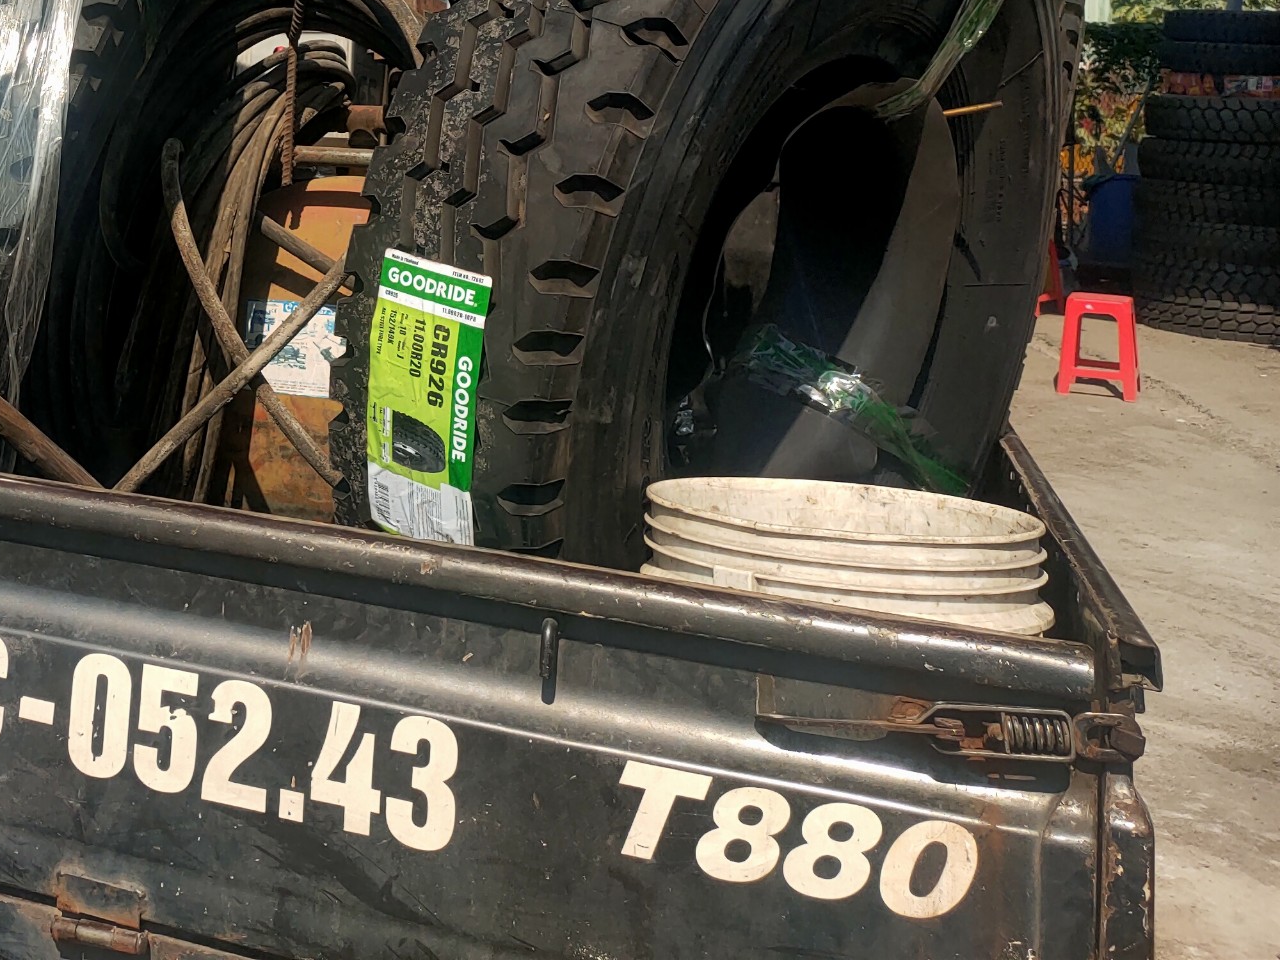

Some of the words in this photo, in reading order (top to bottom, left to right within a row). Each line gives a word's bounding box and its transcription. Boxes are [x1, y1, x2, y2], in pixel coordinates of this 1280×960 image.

[388, 266, 476, 307] GOODRIDE
[409, 319, 427, 378] 11.00R20
[427, 324, 451, 408] CR926
[451, 355, 473, 463] GOODRIDE
[618, 760, 979, 920] T880
